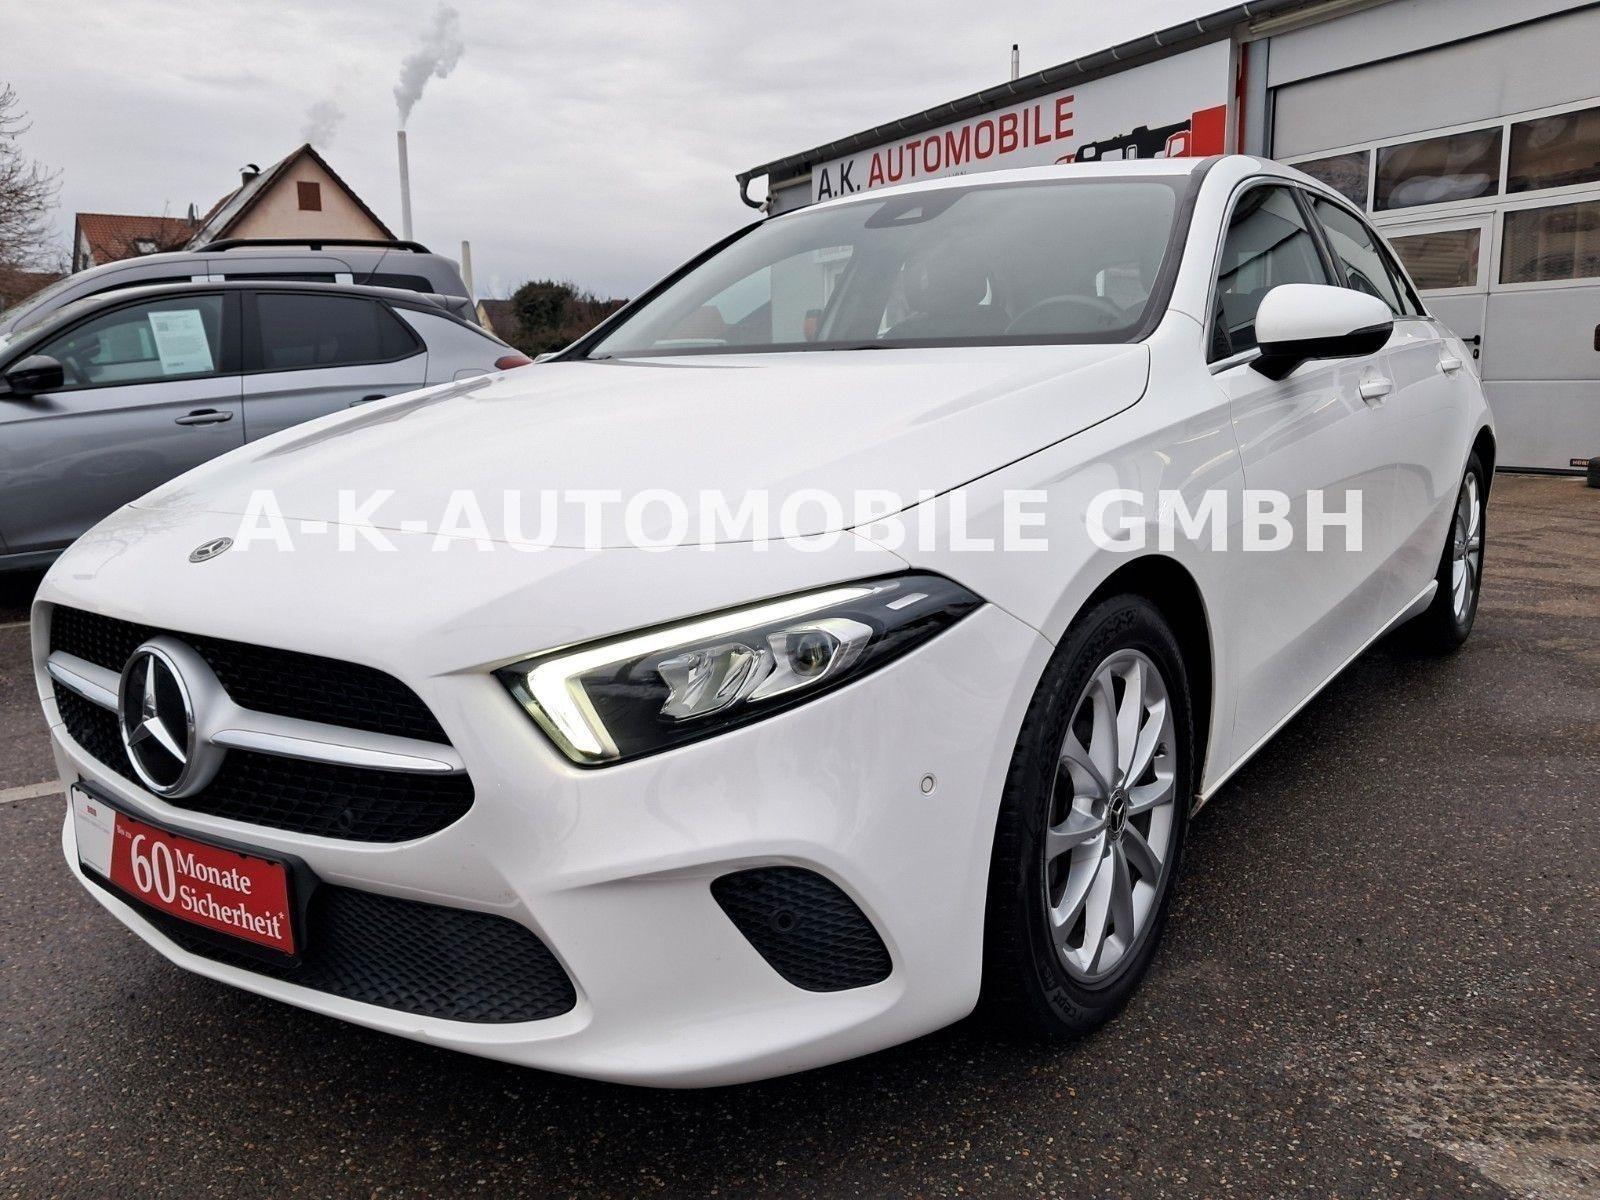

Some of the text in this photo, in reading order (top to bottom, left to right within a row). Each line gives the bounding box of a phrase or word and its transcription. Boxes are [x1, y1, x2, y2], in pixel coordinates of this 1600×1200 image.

[818, 95, 1075, 201] A.K. AUTOMOBILE
[131, 834, 176, 904] 60
[174, 848, 252, 895] Monate
